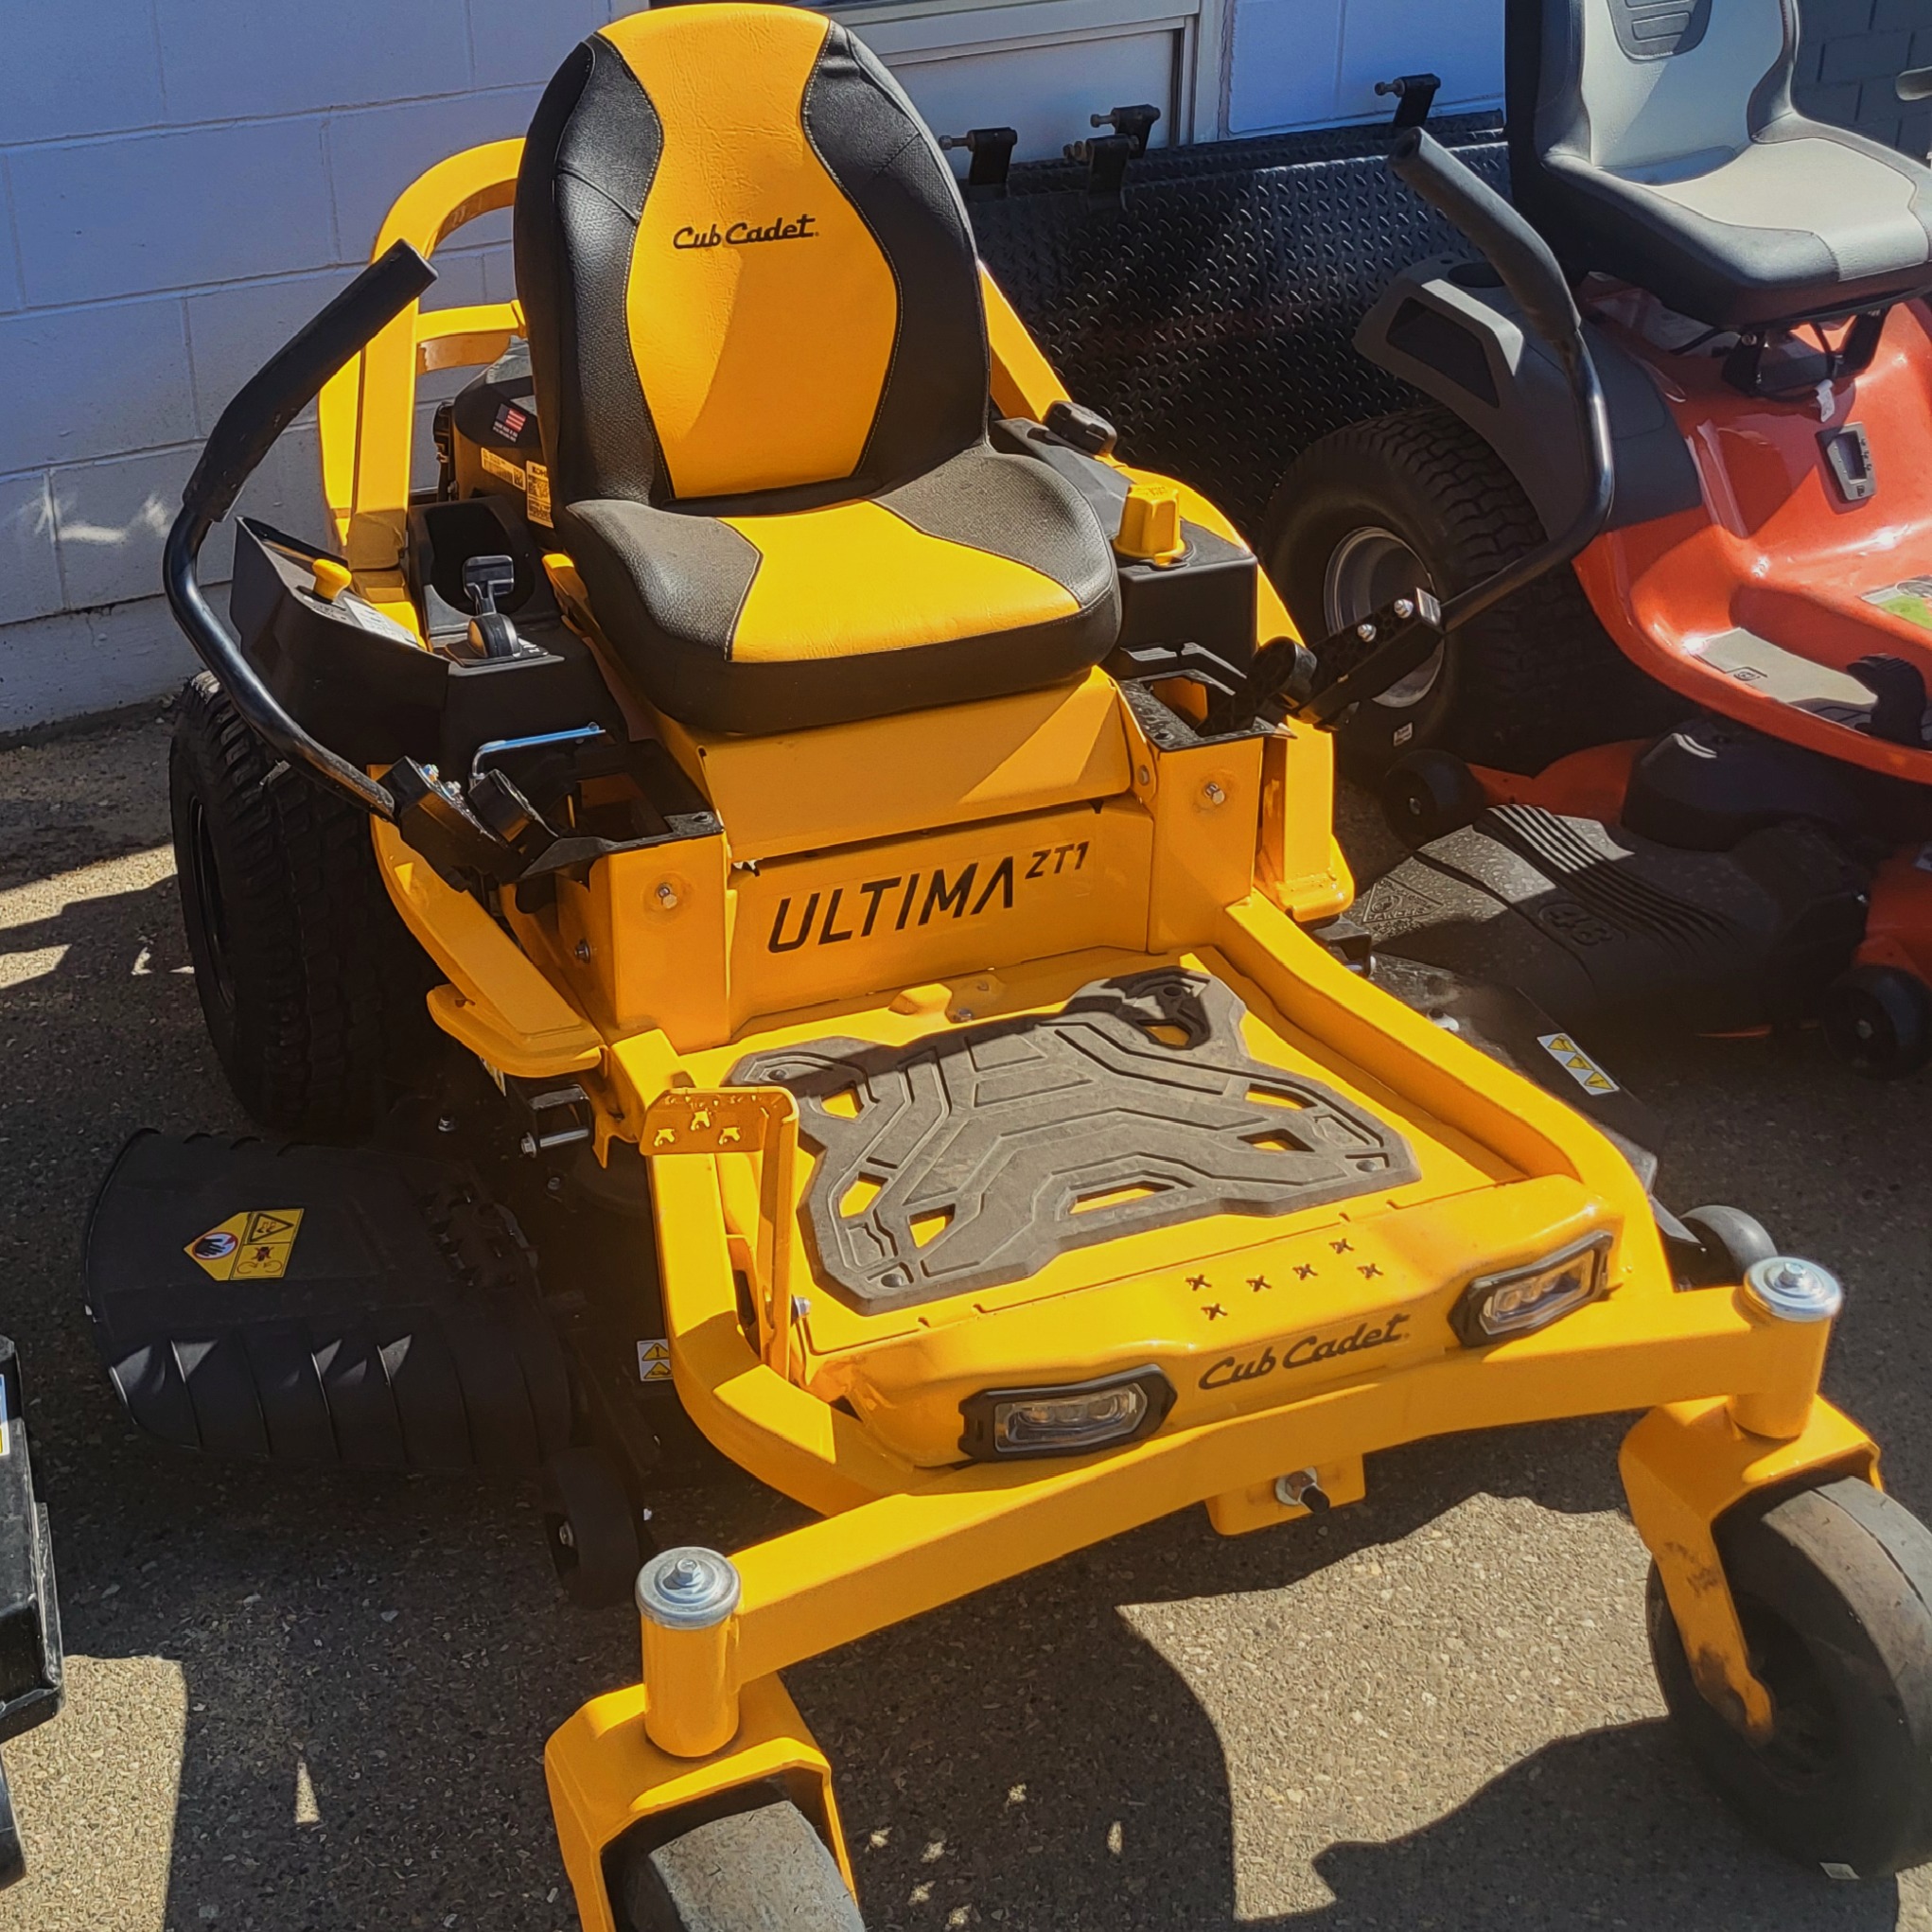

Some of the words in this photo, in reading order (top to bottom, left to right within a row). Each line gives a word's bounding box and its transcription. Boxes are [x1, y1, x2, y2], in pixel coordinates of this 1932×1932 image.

[673, 223, 722, 250] Cub
[726, 213, 817, 245] Cadet
[767, 855, 1013, 954] ULTIMA
[1025, 841, 1090, 880] ZT1
[1198, 1345, 1276, 1390] Cub
[1282, 1312, 1411, 1369] Cadet
